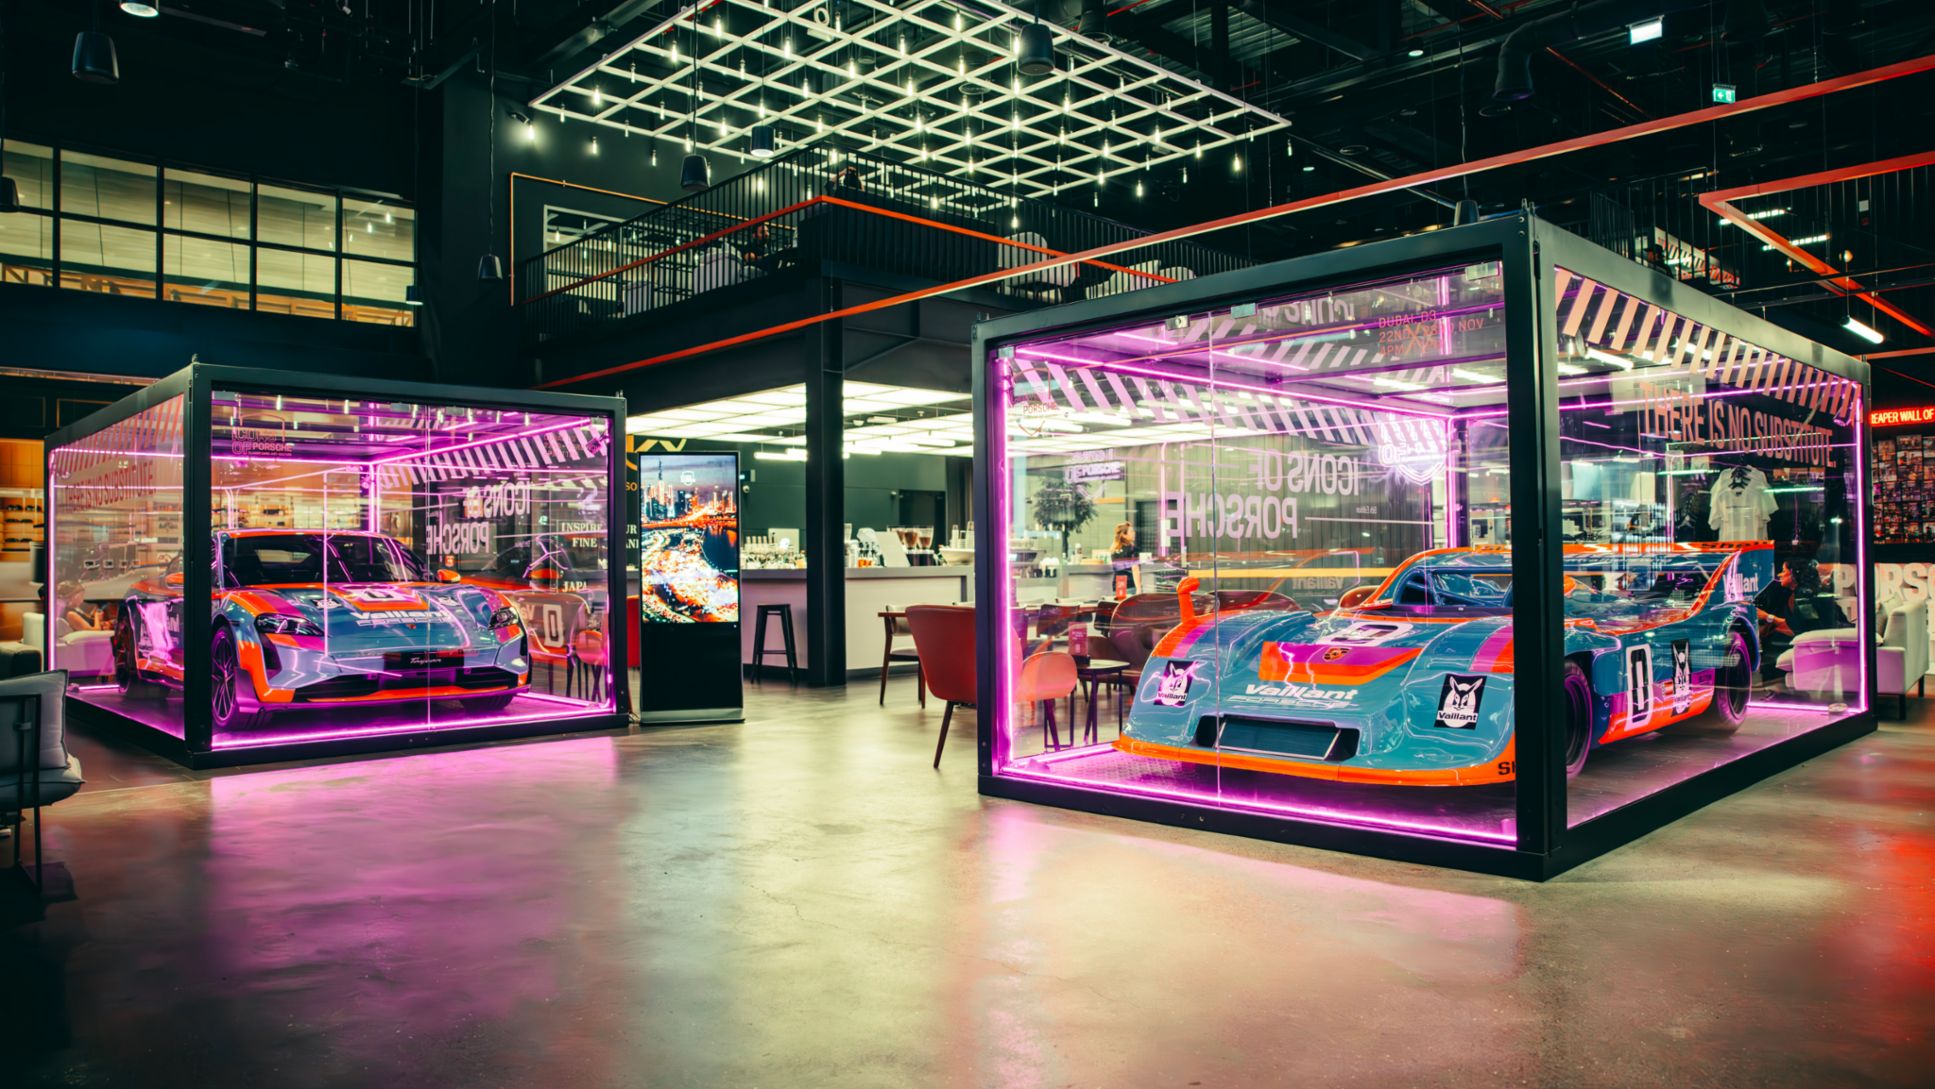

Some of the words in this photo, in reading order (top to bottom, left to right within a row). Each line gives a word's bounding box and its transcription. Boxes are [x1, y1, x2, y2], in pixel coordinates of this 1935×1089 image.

[1458, 318, 1484, 332] NOV
[1900, 410, 1922, 422] WALL
[1923, 408, 1935, 420] OF
[1639, 382, 1705, 446] THERE
[1708, 399, 1725, 450] IS
[1728, 404, 1751, 453] NO
[1754, 411, 1837, 468] SUBSTITUTE.
[252, 442, 293, 452] PORSCHE
[572, 537, 598, 548] FINE
[1157, 692, 1187, 700] Vaillant
[1245, 684, 1359, 700] Vaillant
[1438, 711, 1478, 721] Vaillant
